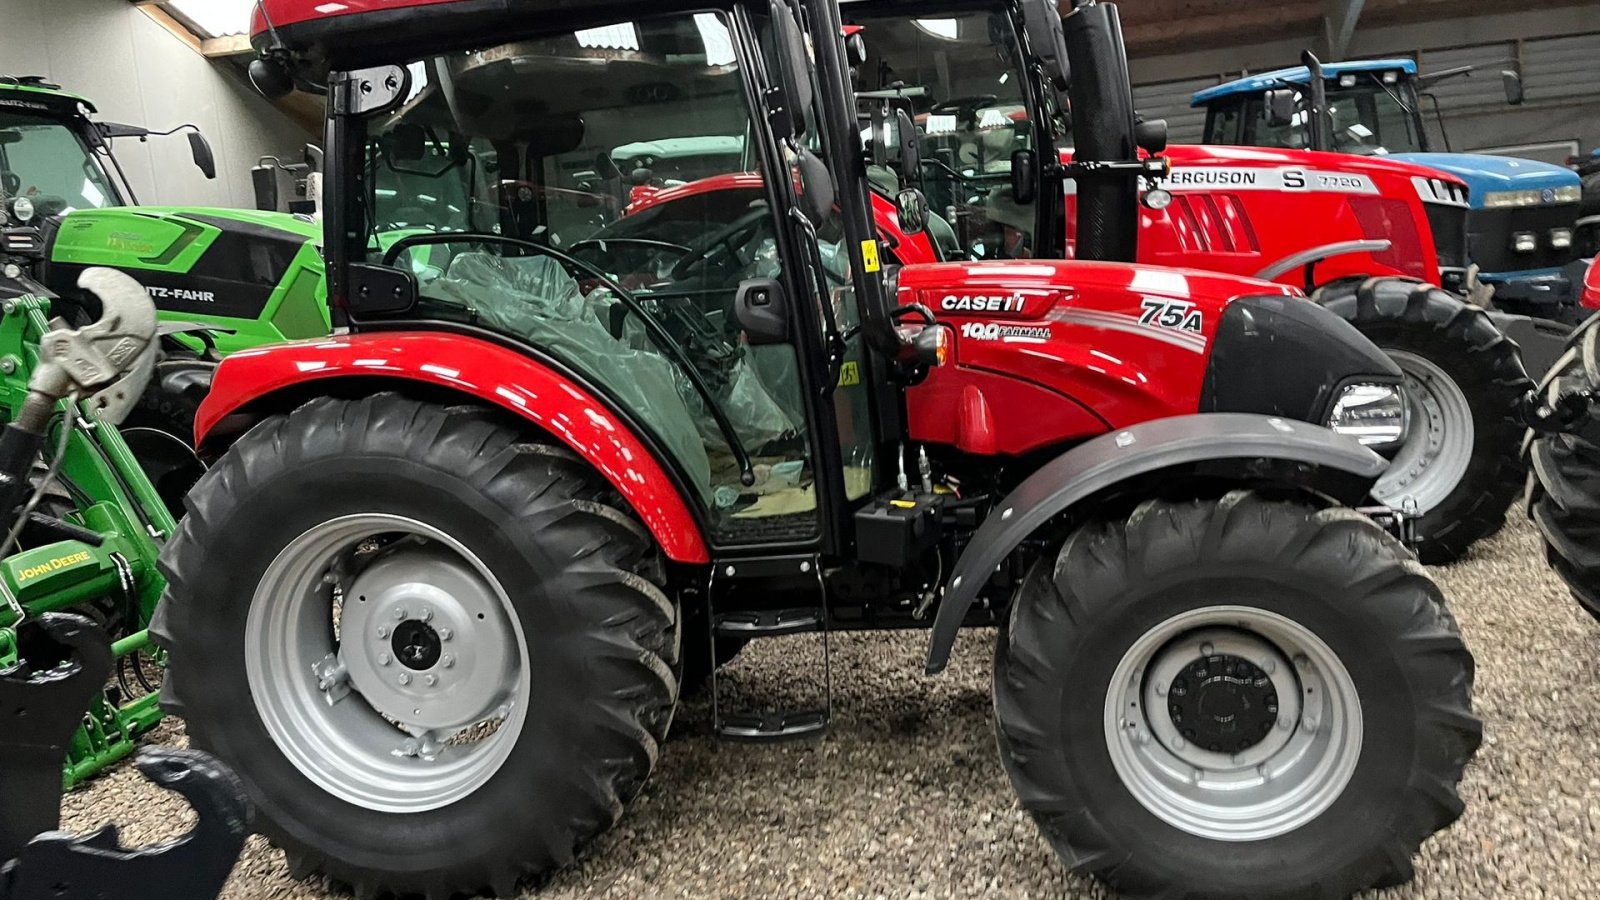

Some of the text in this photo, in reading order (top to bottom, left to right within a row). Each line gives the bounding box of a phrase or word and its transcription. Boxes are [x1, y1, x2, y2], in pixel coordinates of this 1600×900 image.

[1283, 171, 1305, 187] S
[941, 295, 1003, 311] CASE
[1140, 298, 1202, 333] 75A
[960, 322, 999, 338] 100
[999, 326, 1052, 338] FARMALL
[19, 551, 91, 581] JOHN DEERE
